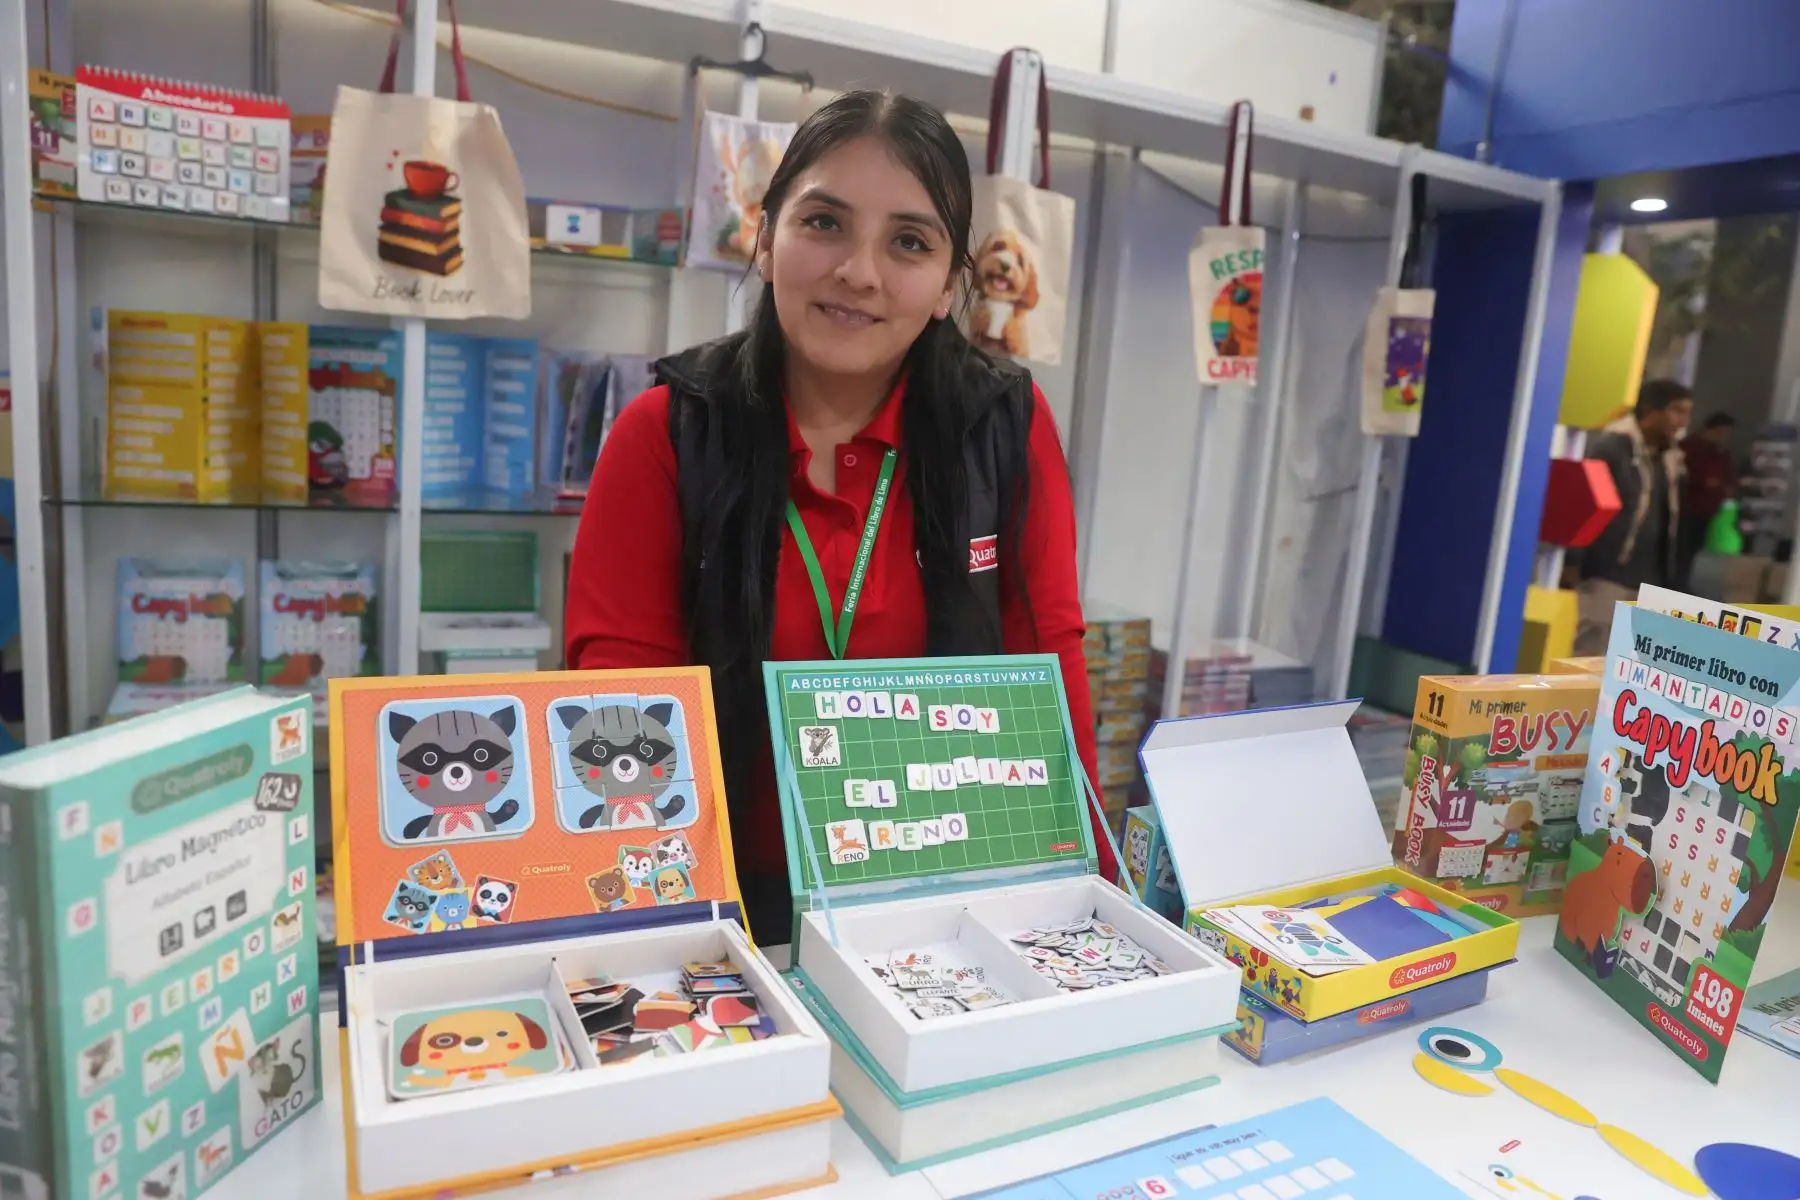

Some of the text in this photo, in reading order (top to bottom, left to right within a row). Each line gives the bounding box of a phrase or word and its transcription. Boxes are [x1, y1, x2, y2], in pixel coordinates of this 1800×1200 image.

[431, 280, 477, 304] Lover
[845, 478, 889, 613] Feria Internacional del Libro de Lima
[1766, 626, 1781, 644] Z
[1633, 634, 1779, 698] Mi primer libro con
[822, 694, 993, 729] HOLA SOY
[1429, 691, 1444, 717] 11
[1469, 699, 1526, 717] Mi primer
[1619, 661, 1789, 736] IMANTADOS
[1488, 709, 1590, 756] BUSY
[805, 756, 839, 766] KOALA
[1601, 757, 1612, 773] A
[853, 763, 1044, 803] EL JULIAN
[1416, 754, 1437, 809] BUSY
[1603, 787, 1612, 802] B
[1449, 796, 1467, 823] 11
[1593, 808, 1602, 823] C
[294, 822, 303, 839] L
[877, 817, 963, 846] RENO
[1405, 812, 1425, 865] BOOK
[1676, 807, 1726, 844] S S S
[837, 852, 864, 864] RENO
[1669, 834, 1698, 860] S S
[126, 854, 176, 886] Libro
[532, 864, 571, 874] Quatroly
[1407, 957, 1452, 981] Quatroly
[1693, 971, 1734, 1018] 198
[1369, 1001, 1406, 1021] Quatroly
[1686, 999, 1725, 1037] Imanes
[1661, 1014, 1702, 1055] Quatroly
[143, 1109, 163, 1136] V
[254, 1090, 303, 1139] GATO
[1146, 1179, 1166, 1194] 6
